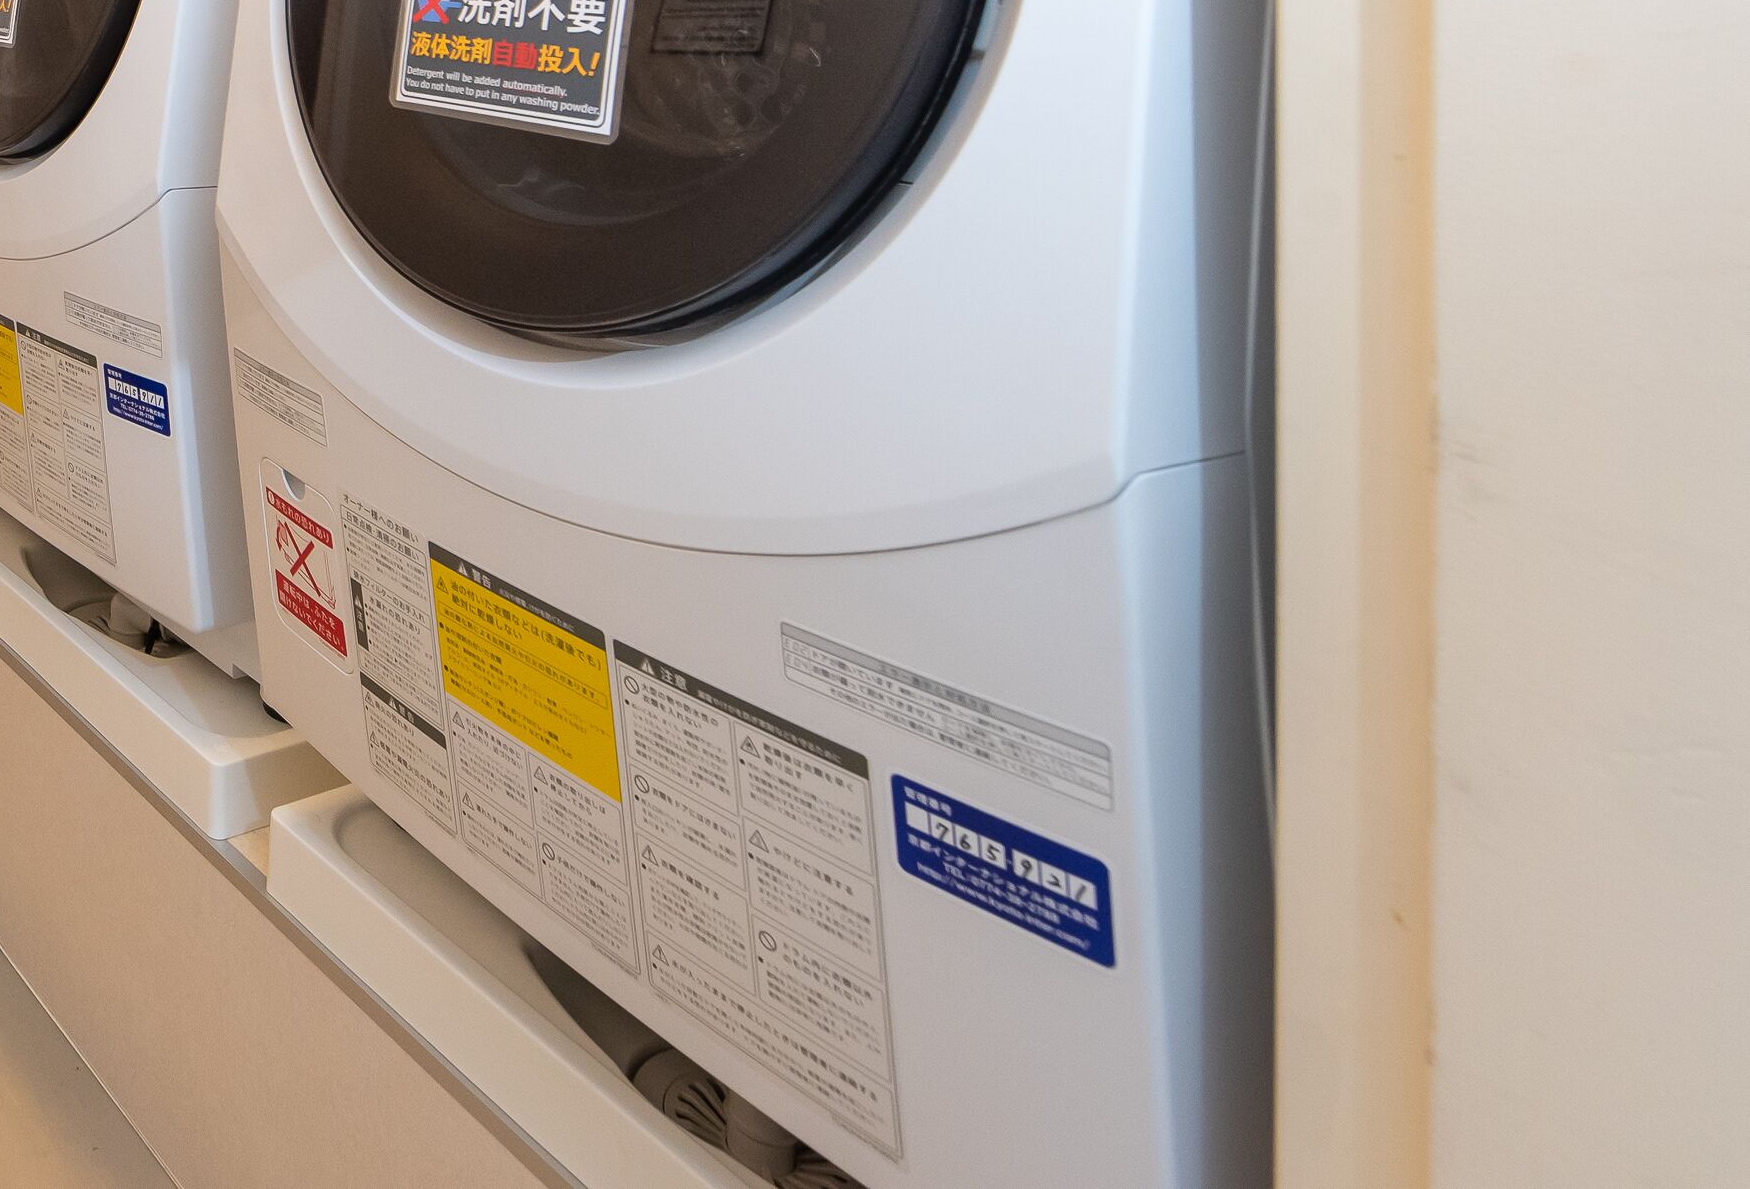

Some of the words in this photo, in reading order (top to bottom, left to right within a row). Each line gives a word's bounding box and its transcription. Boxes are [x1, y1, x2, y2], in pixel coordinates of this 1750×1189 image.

[406, 65, 445, 80] Detergent
[446, 70, 461, 81] will
[461, 72, 473, 83] be
[474, 74, 501, 87] added
[502, 79, 568, 97] automatically.
[406, 77, 420, 88] You
[420, 79, 431, 89] do
[431, 81, 444, 92] not
[445, 82, 465, 95] have
[465, 87, 474, 96] to
[475, 88, 490, 100] put
[491, 89, 500, 100] in
[500, 93, 518, 105] any
[519, 94, 558, 111] washing
[559, 100, 600, 115] powder.
[342, 493, 419, 543] オーナー様へのお願い
[471, 568, 492, 590] 警告
[451, 594, 522, 640] 絶対に乾燥しない
[659, 666, 688, 691] 注意
[643, 694, 702, 729] 衣類を入れない
